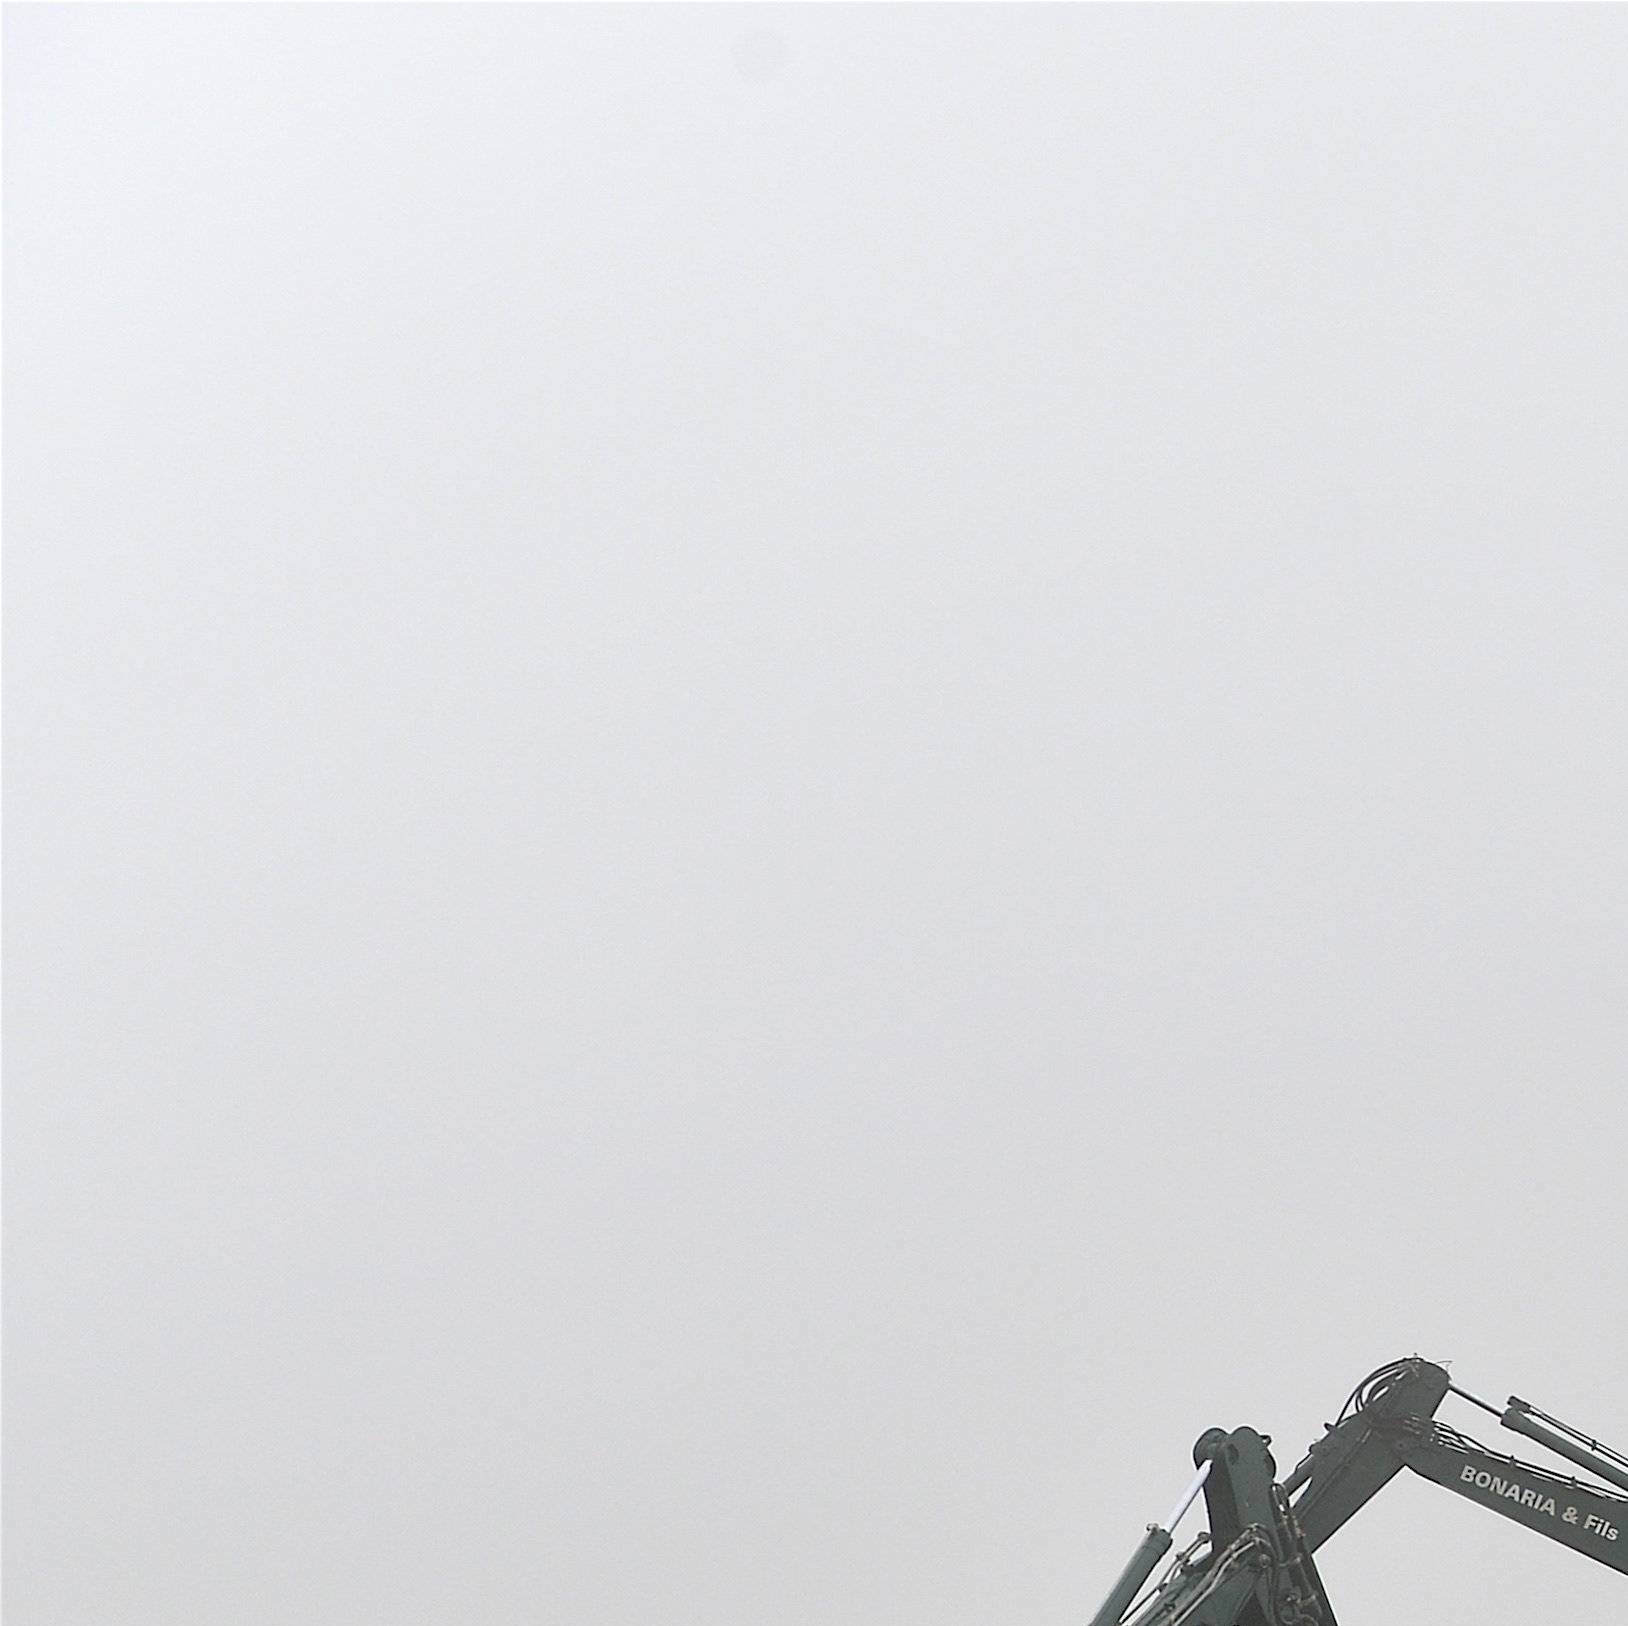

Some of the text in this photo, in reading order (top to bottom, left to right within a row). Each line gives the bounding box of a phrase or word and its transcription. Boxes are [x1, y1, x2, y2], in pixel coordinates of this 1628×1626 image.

[1460, 1465, 1619, 1541] BONARIA & Fils
